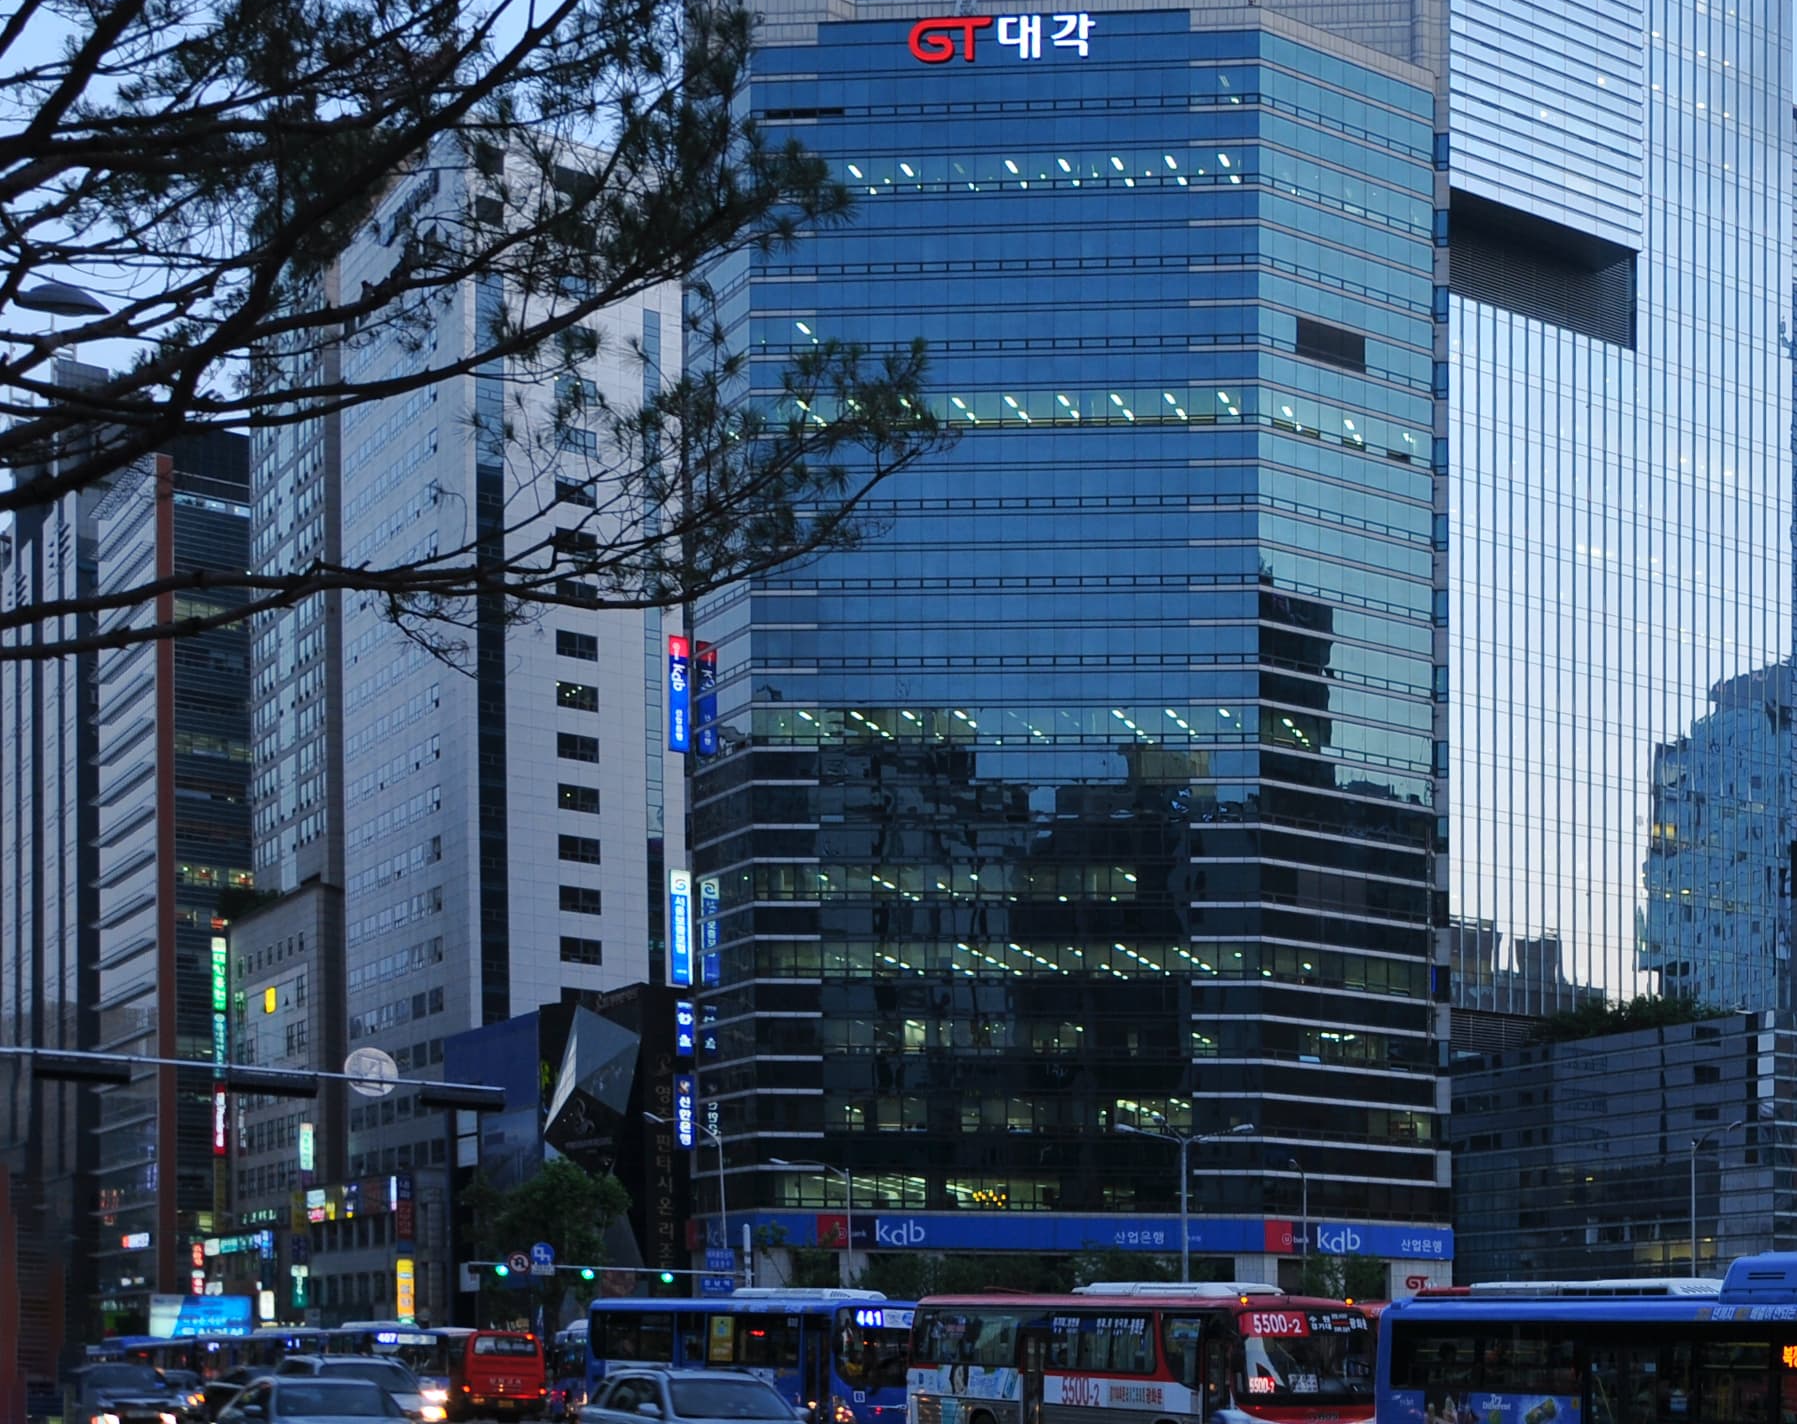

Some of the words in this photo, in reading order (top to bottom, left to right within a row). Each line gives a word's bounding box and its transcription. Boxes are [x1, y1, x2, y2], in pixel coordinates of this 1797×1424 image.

[908, 16, 992, 63] GT
[996, 13, 1096, 59] 대각
[875, 1219, 926, 1246] kdb
[1113, 1231, 1166, 1245] 산업은행
[1316, 1227, 1361, 1253] kdb
[1400, 1238, 1443, 1253] 산업은행
[856, 1309, 882, 1326] 441
[1252, 1313, 1302, 1334] 5500-2
[1062, 1376, 1100, 1406] 5500-2
[1248, 1377, 1275, 1393] 5500-2
